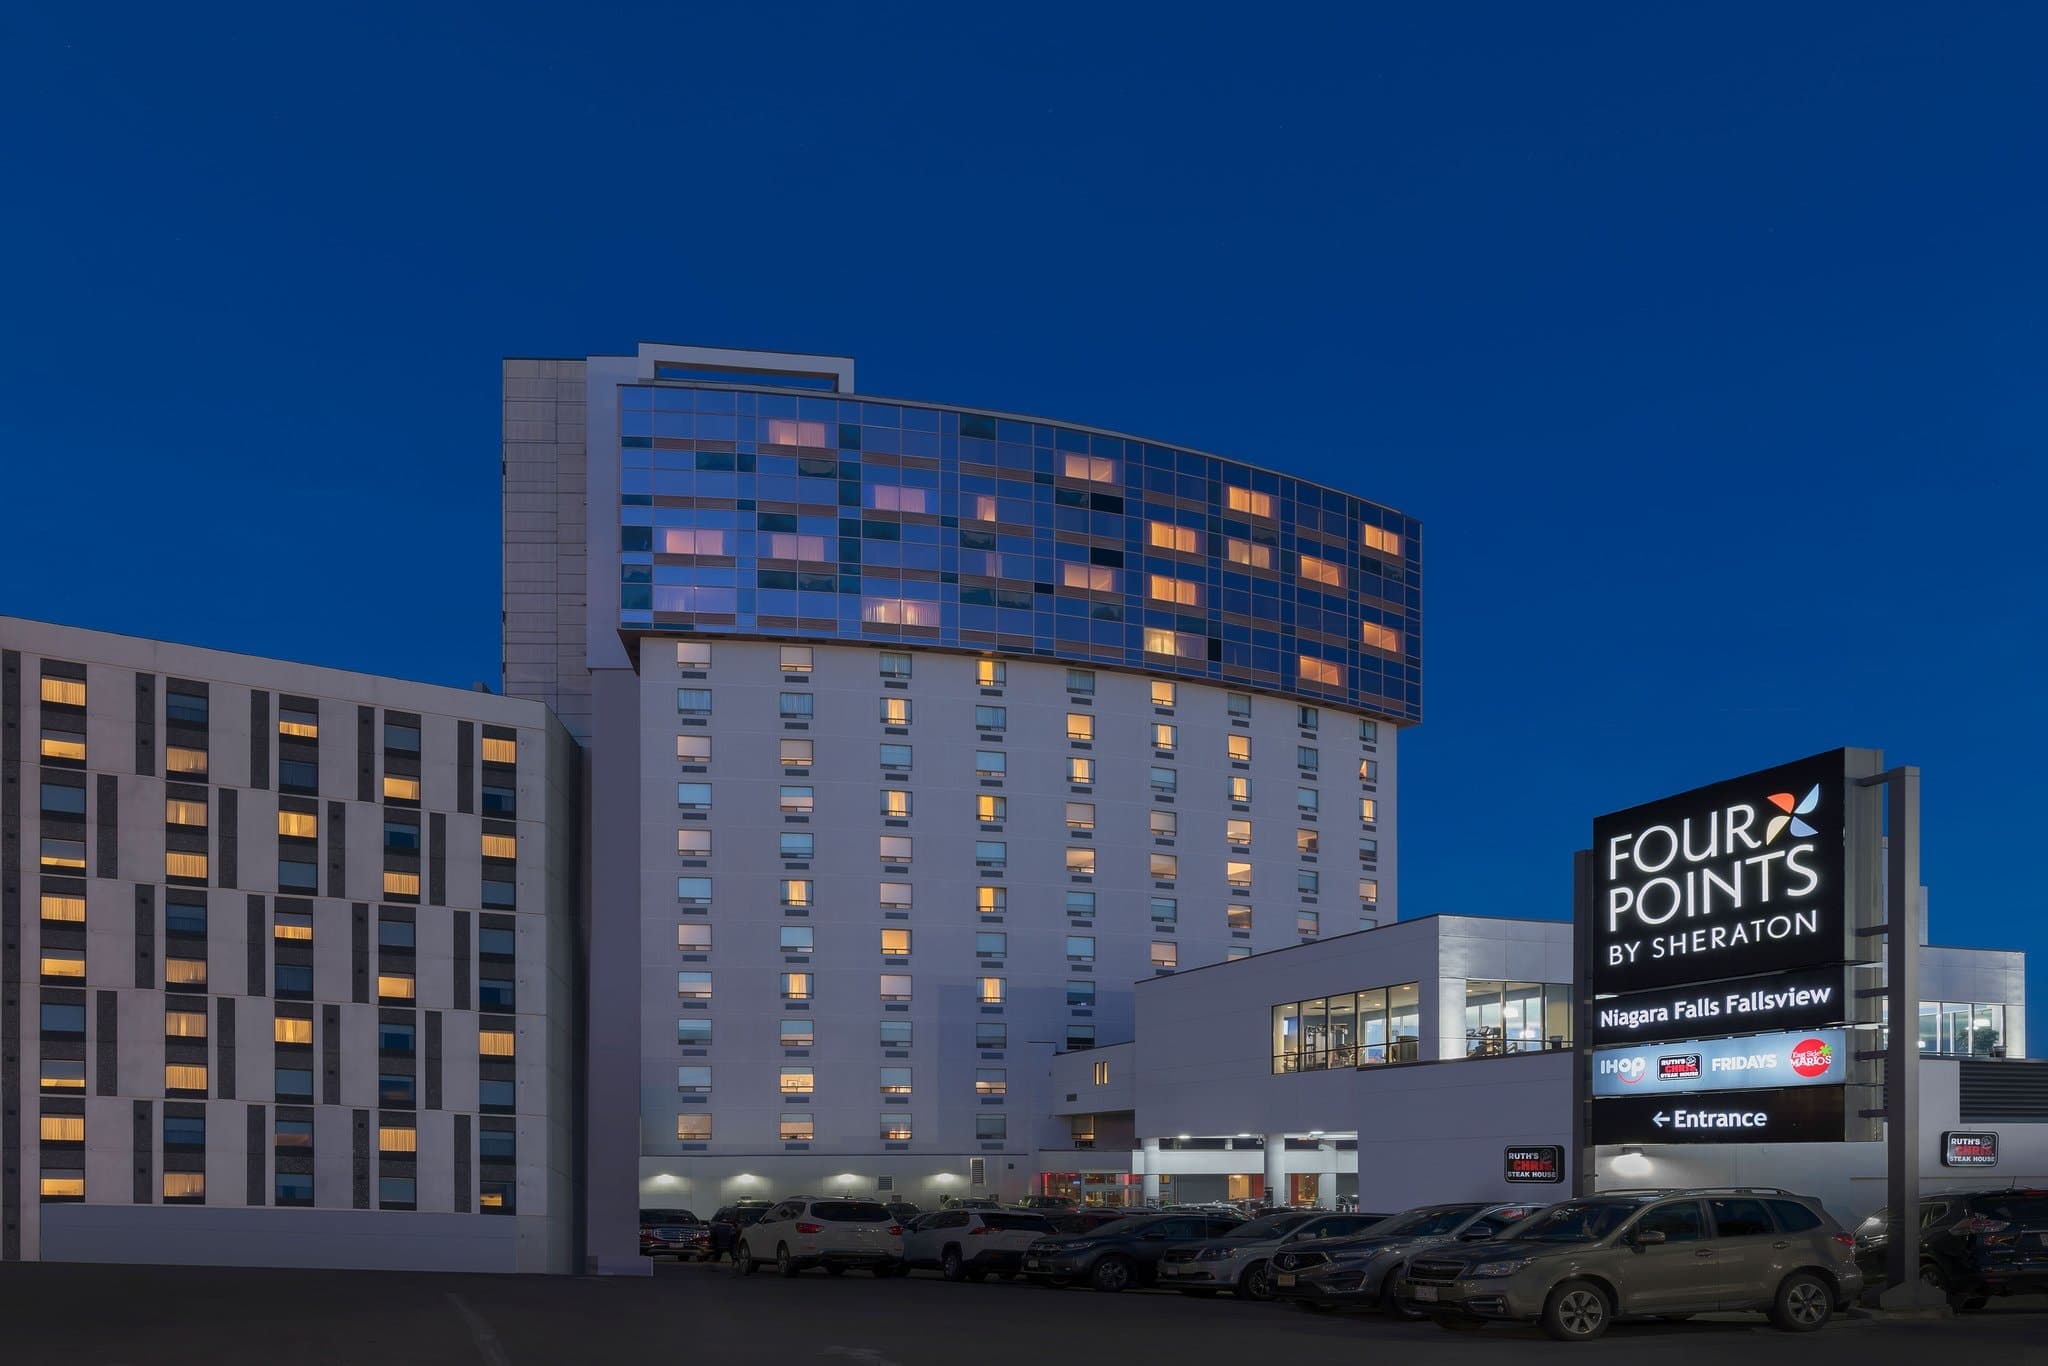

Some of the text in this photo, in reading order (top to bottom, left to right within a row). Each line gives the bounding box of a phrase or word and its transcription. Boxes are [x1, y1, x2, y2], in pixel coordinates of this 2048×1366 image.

[1610, 804, 1762, 880] FOUR
[1609, 844, 1818, 932] POINTS
[1609, 910, 1817, 966] BY SHERATON
[1600, 987, 1831, 1029] Niagara Falls Fallsview
[1711, 1054, 1777, 1071] FRIDAYS
[1674, 1110, 1767, 1128] Entrance
[1508, 1152, 1540, 1160] RUTH'S
